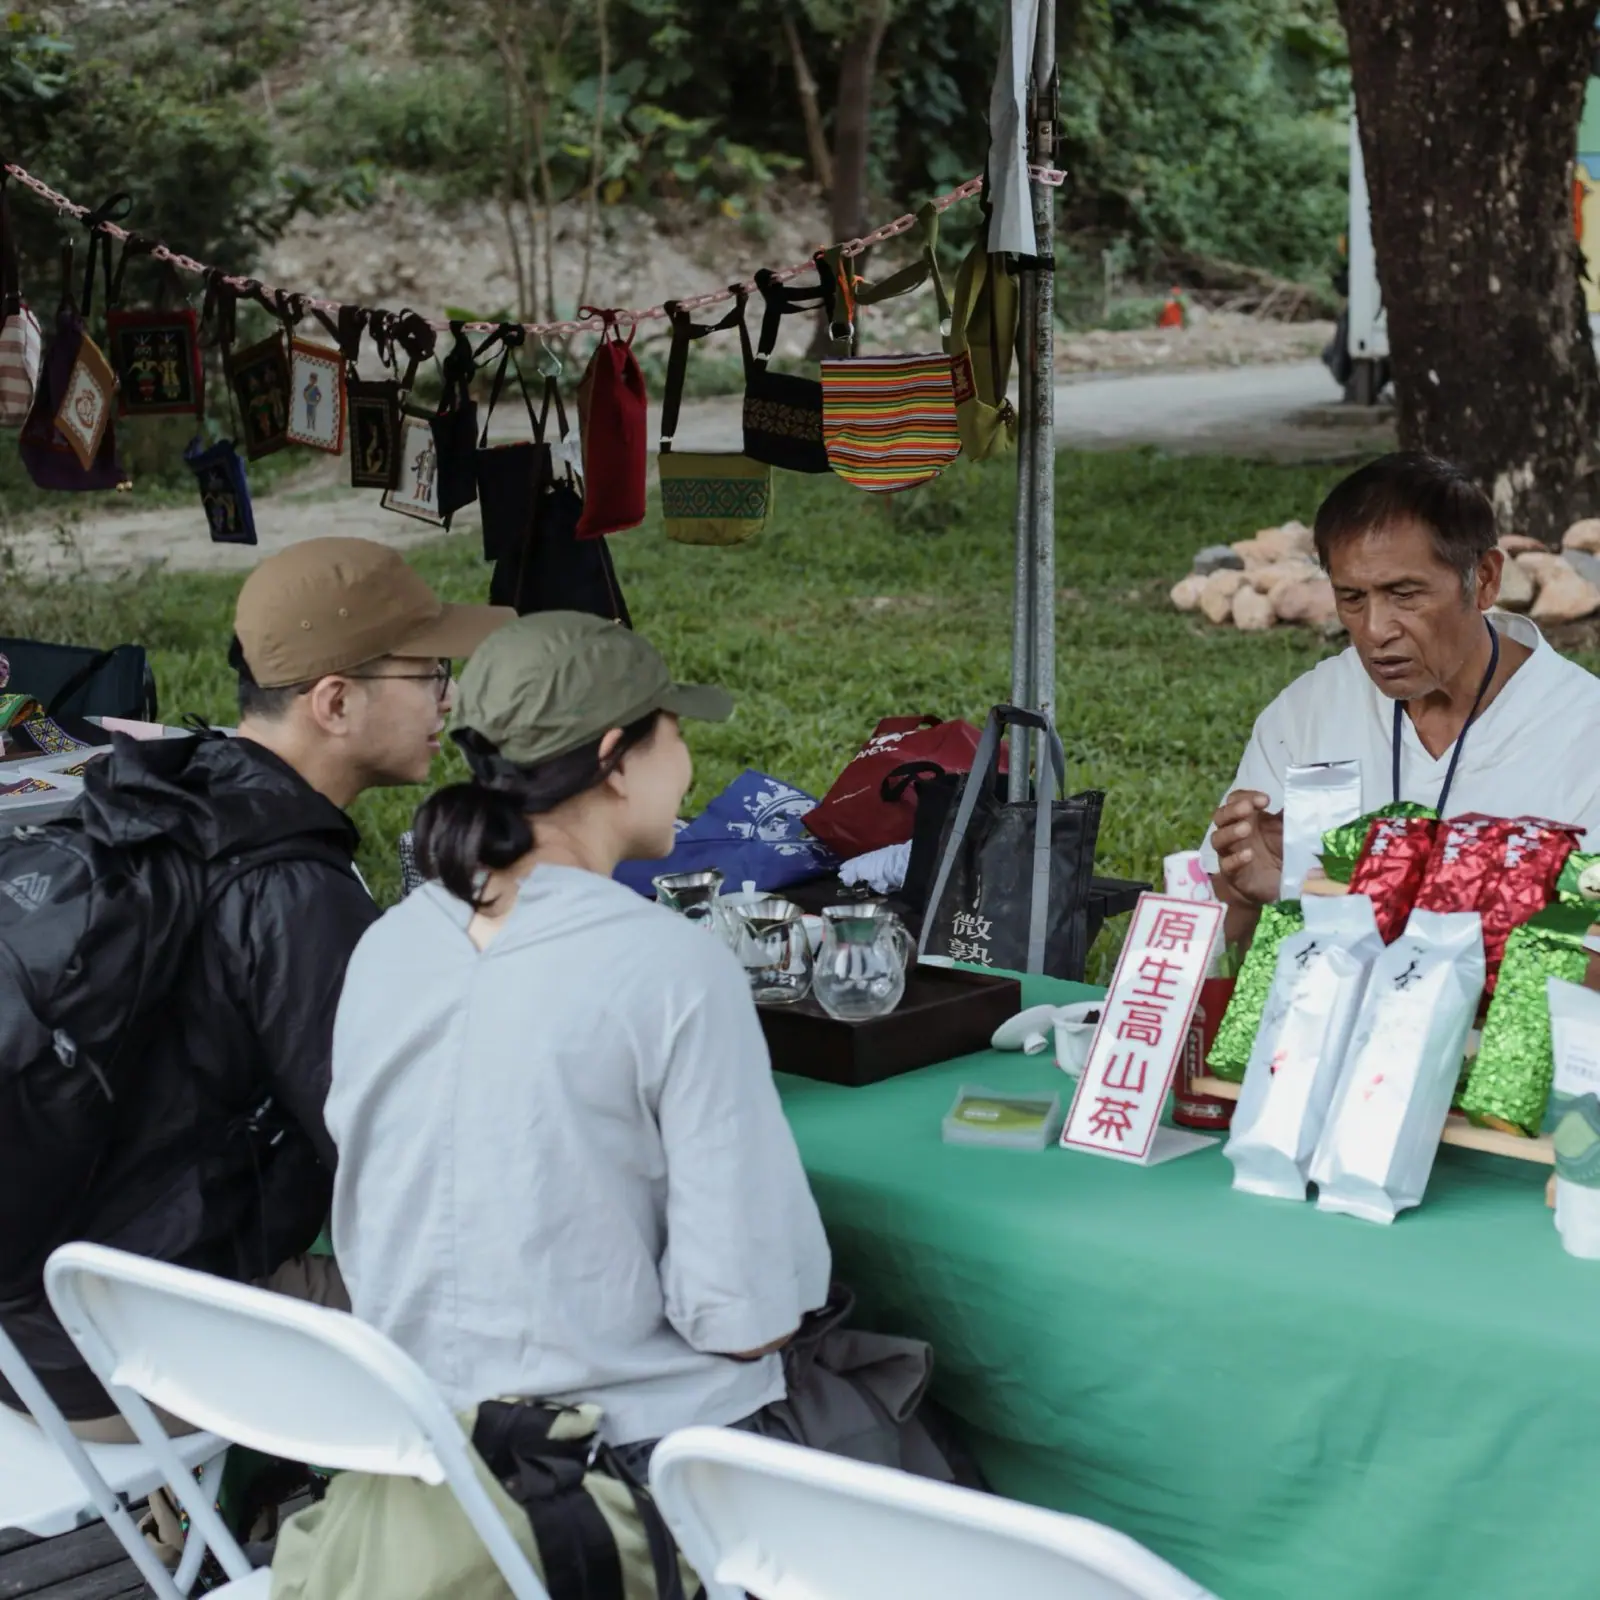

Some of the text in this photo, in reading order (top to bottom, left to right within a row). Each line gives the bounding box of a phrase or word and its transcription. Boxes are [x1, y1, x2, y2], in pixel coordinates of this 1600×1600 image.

[1088, 908, 1199, 1141] 原生高山茶
